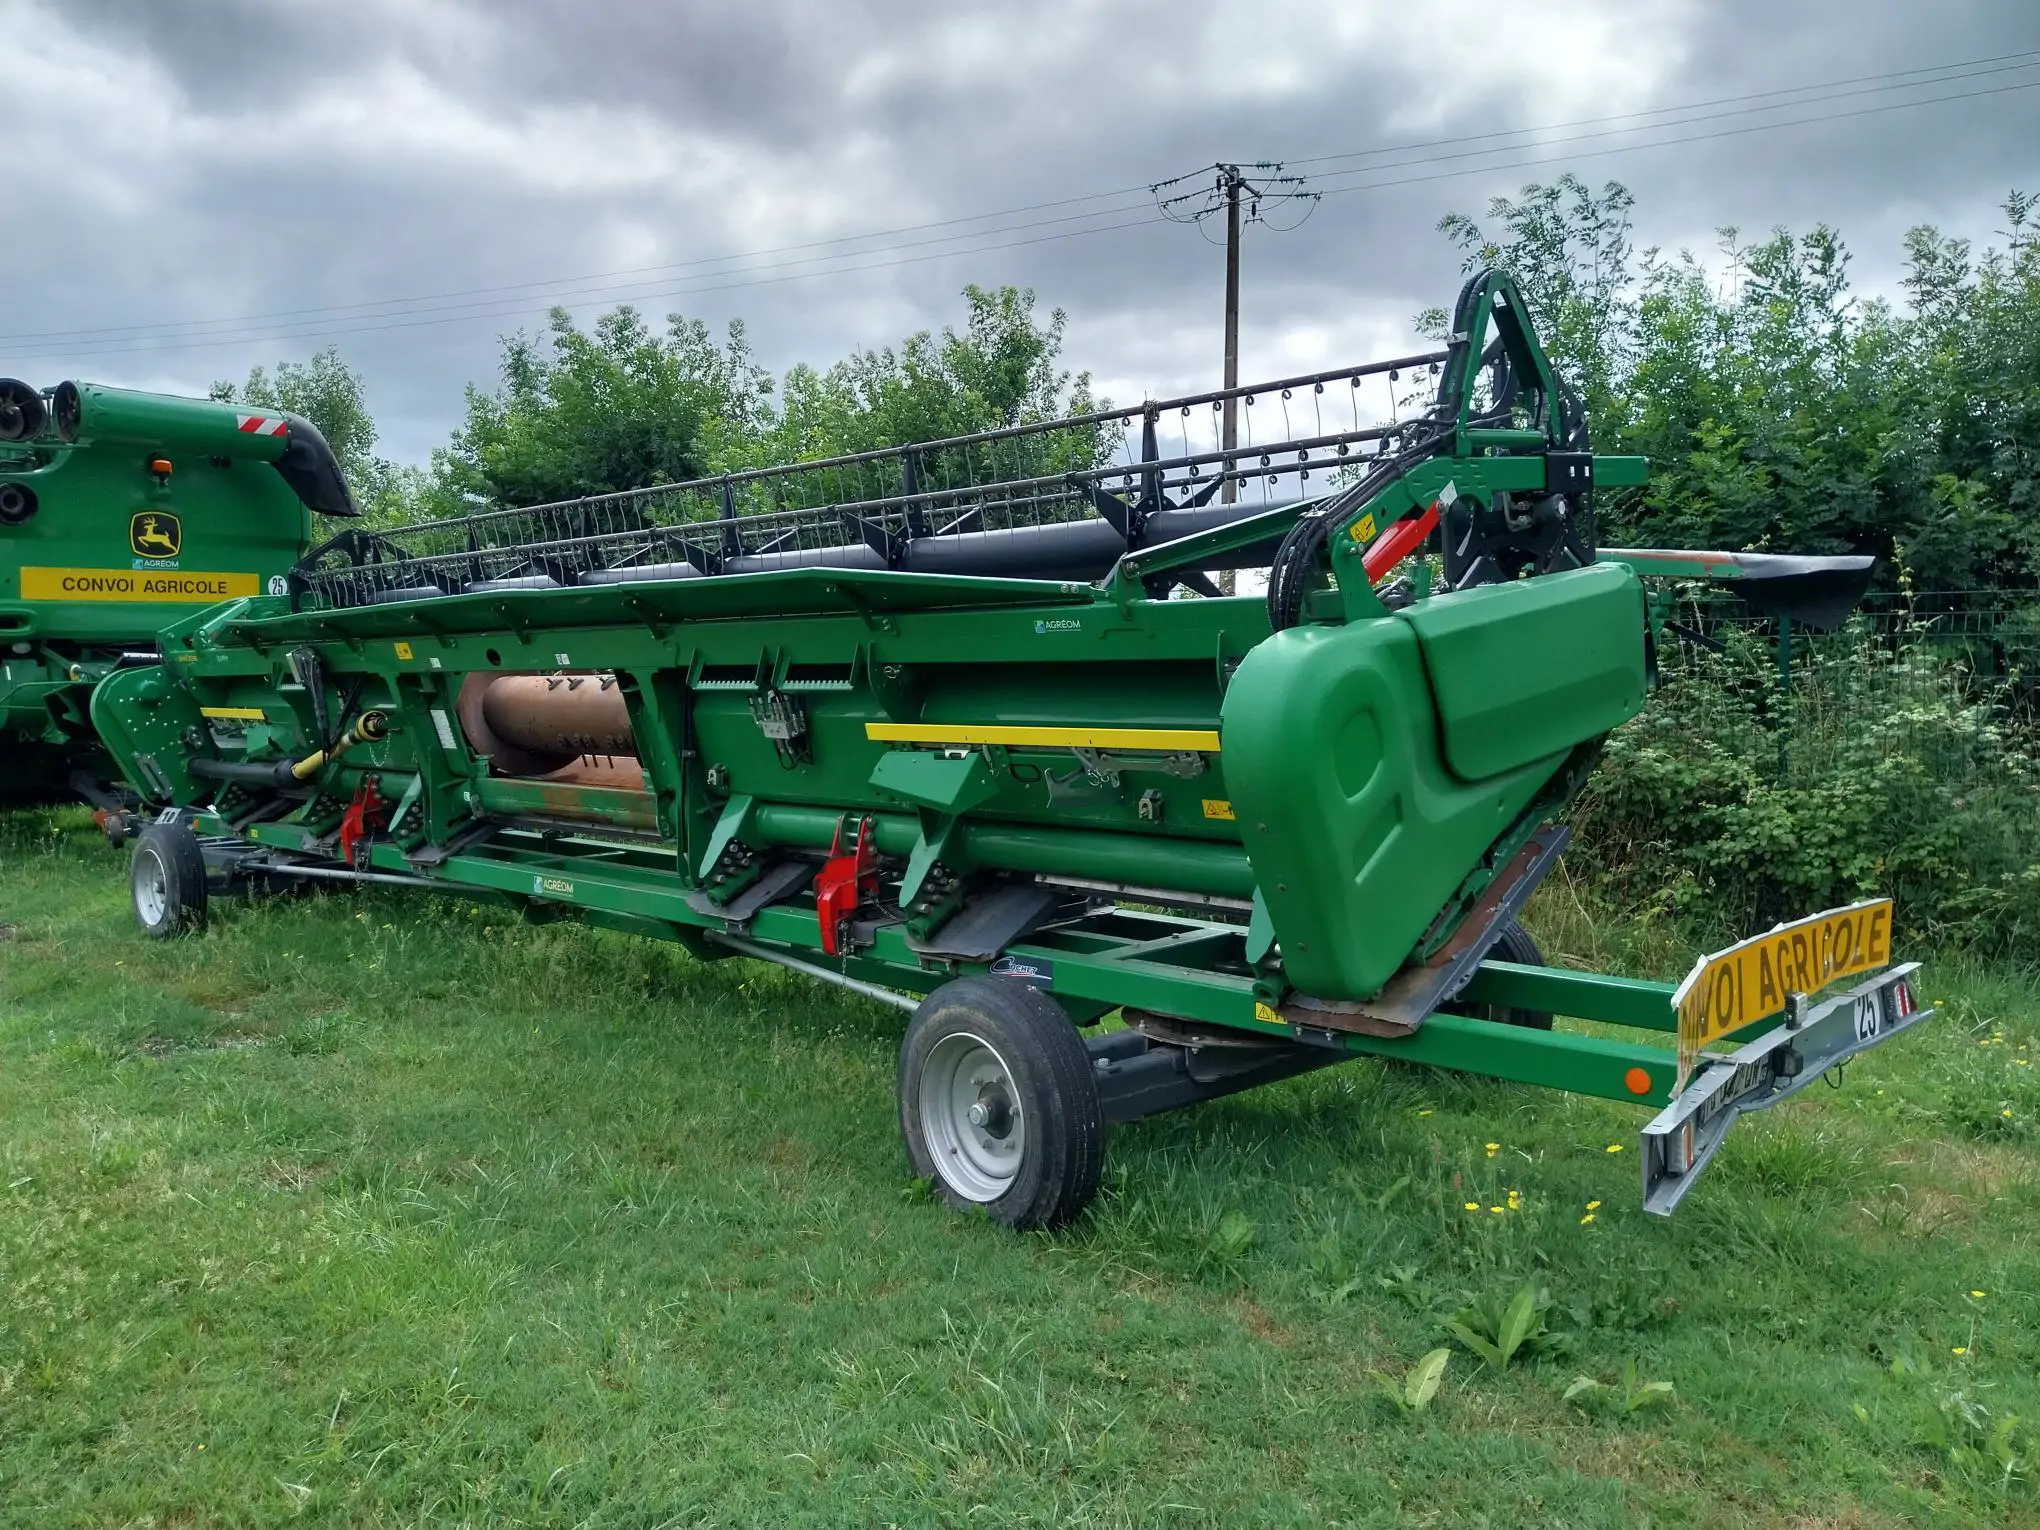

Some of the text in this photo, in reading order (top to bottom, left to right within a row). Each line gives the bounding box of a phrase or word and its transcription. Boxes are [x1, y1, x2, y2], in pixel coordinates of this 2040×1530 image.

[62, 576, 227, 594] CONVOI AGRICOLE
[272, 577, 283, 595] 25
[1760, 908, 1886, 1011] AGRICOLE
[1857, 992, 1876, 1040] 25
